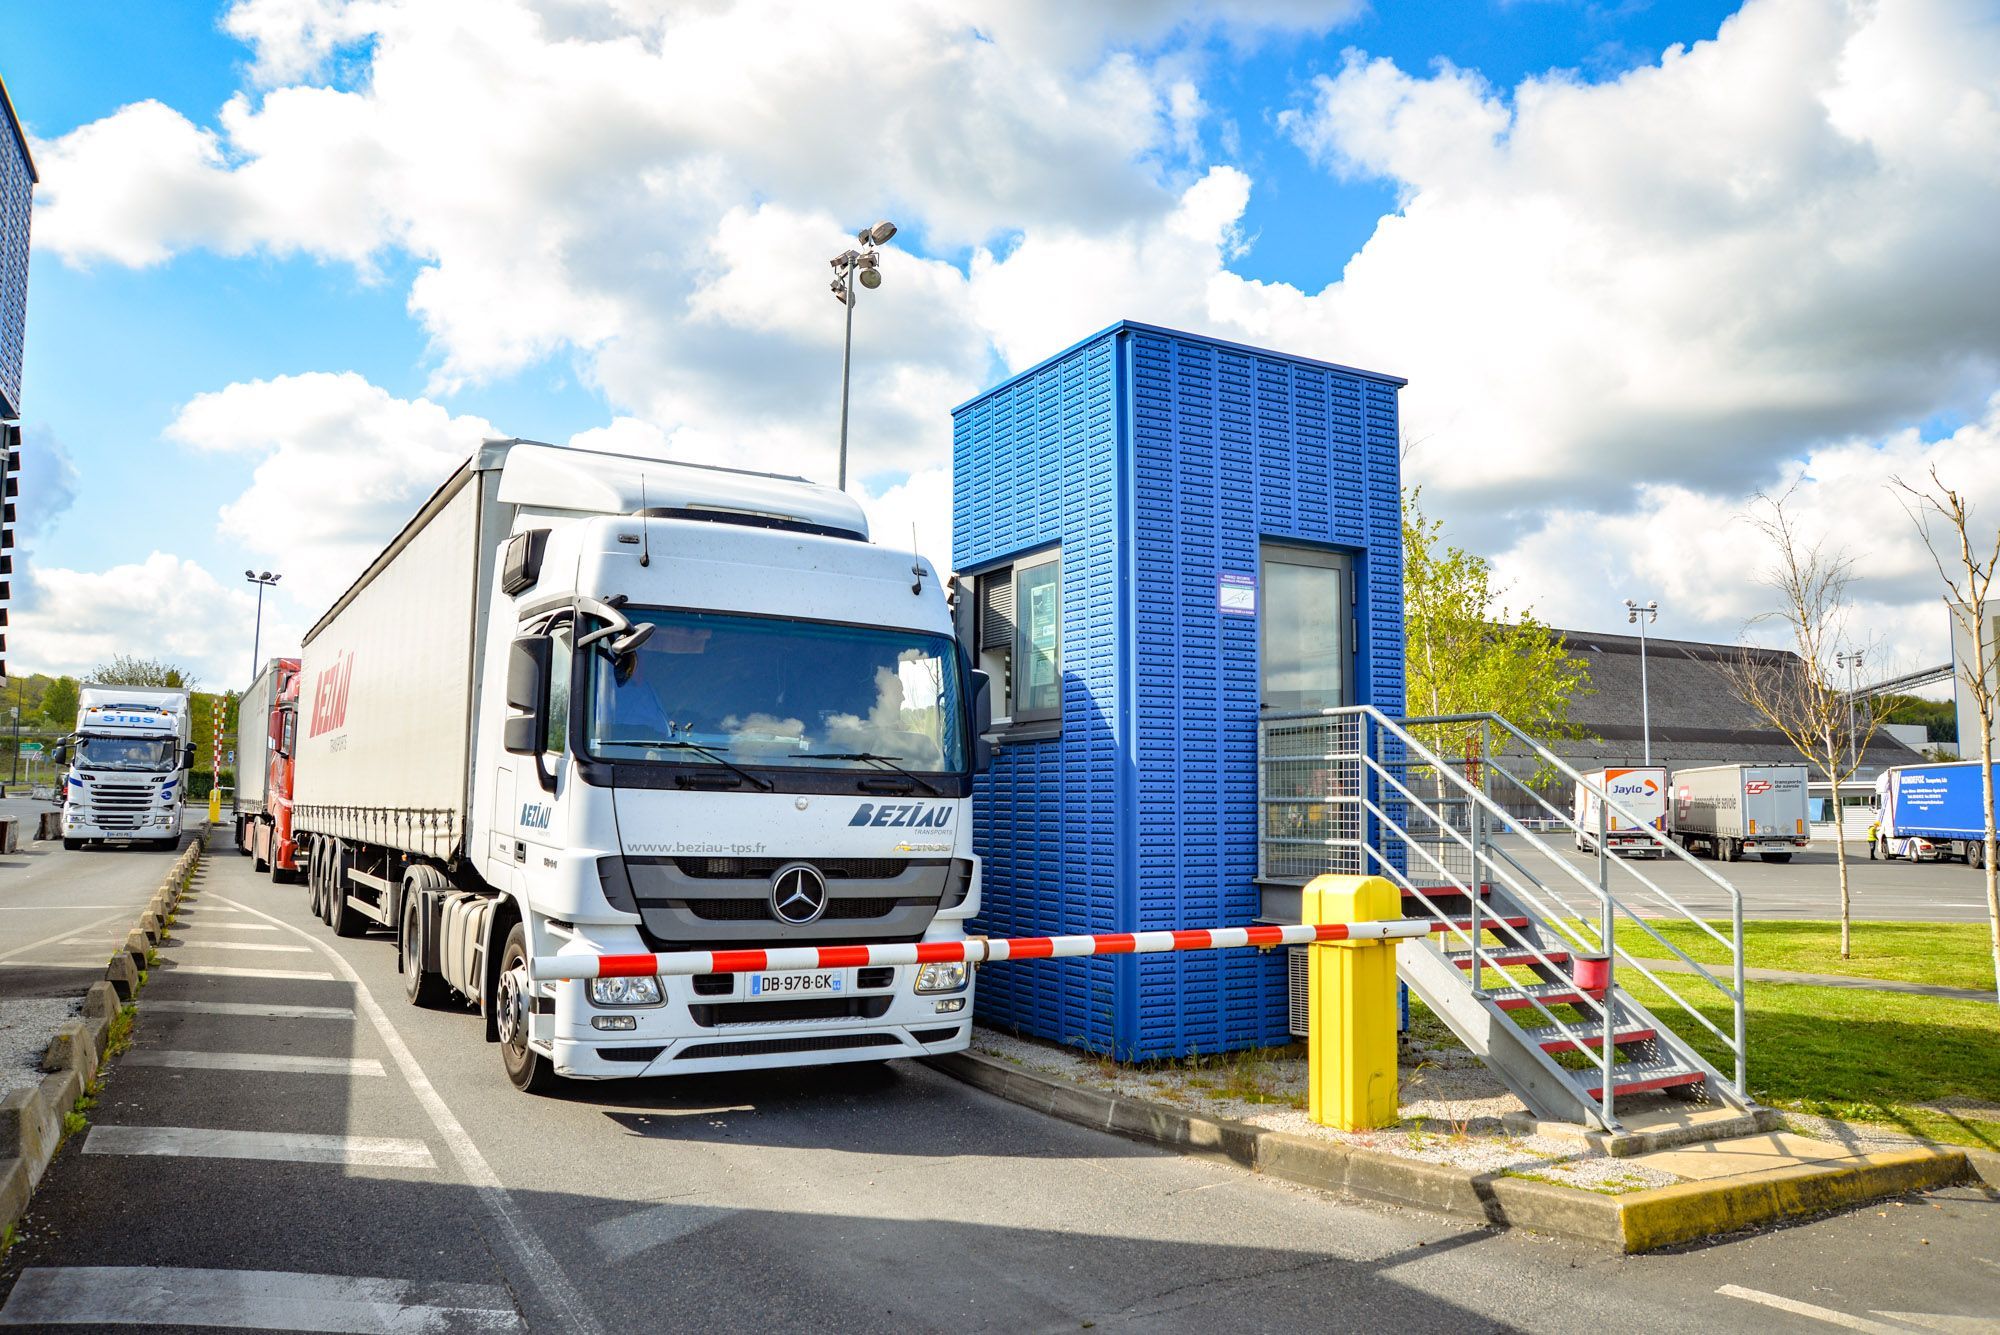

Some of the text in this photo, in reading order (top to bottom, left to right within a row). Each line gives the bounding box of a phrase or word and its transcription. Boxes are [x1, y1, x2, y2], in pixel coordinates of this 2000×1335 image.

[309, 648, 355, 739] BEZIAU
[103, 714, 155, 724] STBS
[1612, 785, 1643, 796] Jaylo
[519, 802, 552, 829] BEZIAU
[848, 802, 953, 828] BEZIAU
[627, 841, 767, 855] www.beziau-tps.fr
[762, 974, 832, 992] DB-978-CK
